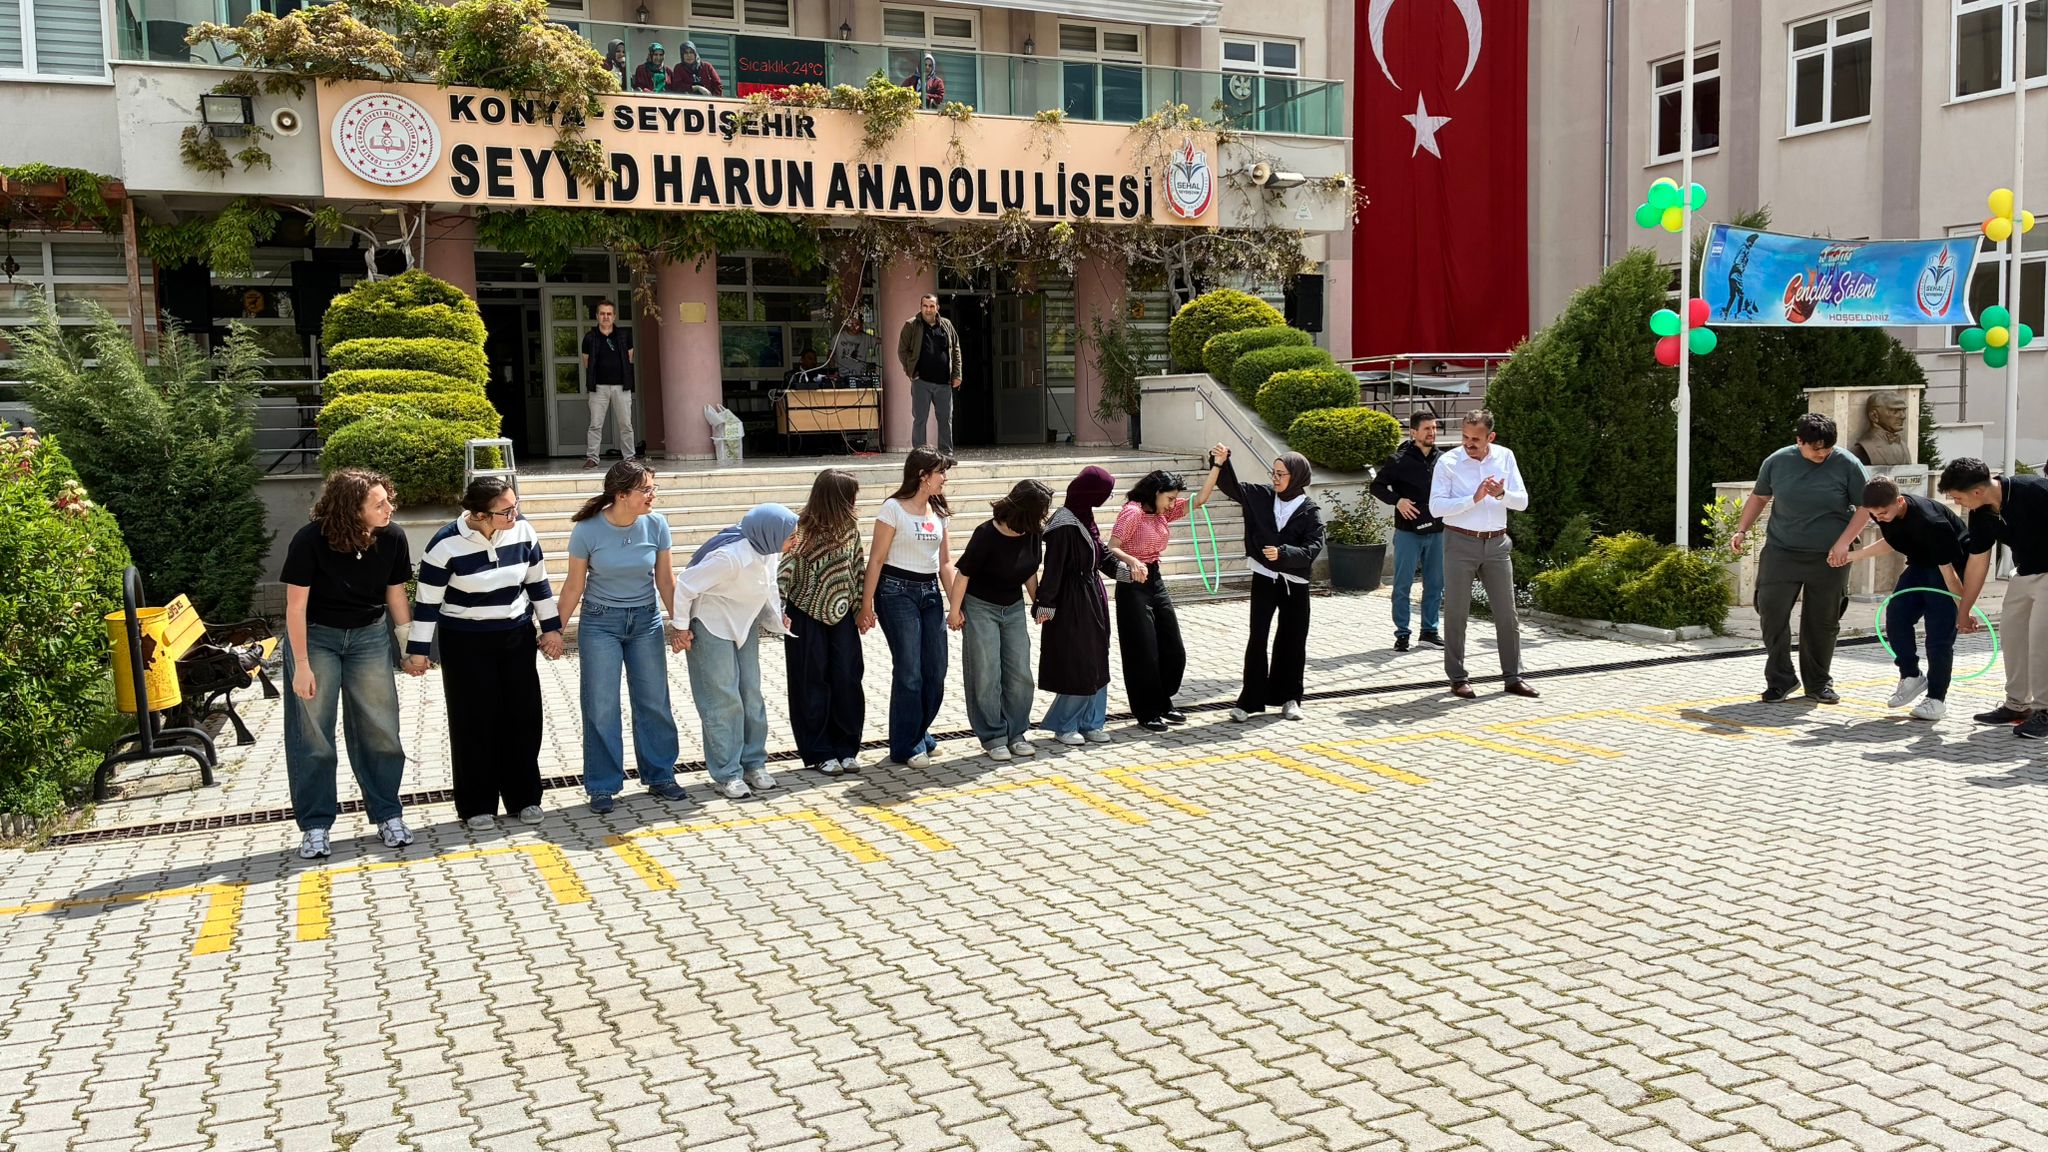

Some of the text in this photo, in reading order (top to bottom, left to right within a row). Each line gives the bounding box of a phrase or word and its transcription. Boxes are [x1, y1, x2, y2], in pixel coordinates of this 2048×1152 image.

[792, 61, 824, 76] 24°C
[612, 103, 818, 141] SEYDİŞEHİR
[652, 153, 815, 208] HARUN
[825, 159, 1025, 215] ANADOLU
[1034, 161, 1153, 219] LİSESİ
[1177, 181, 1200, 190] SEHAL
[1783, 273, 1833, 318] Gençlik
[1829, 312, 1889, 324] HOŞGELDİNİZ
